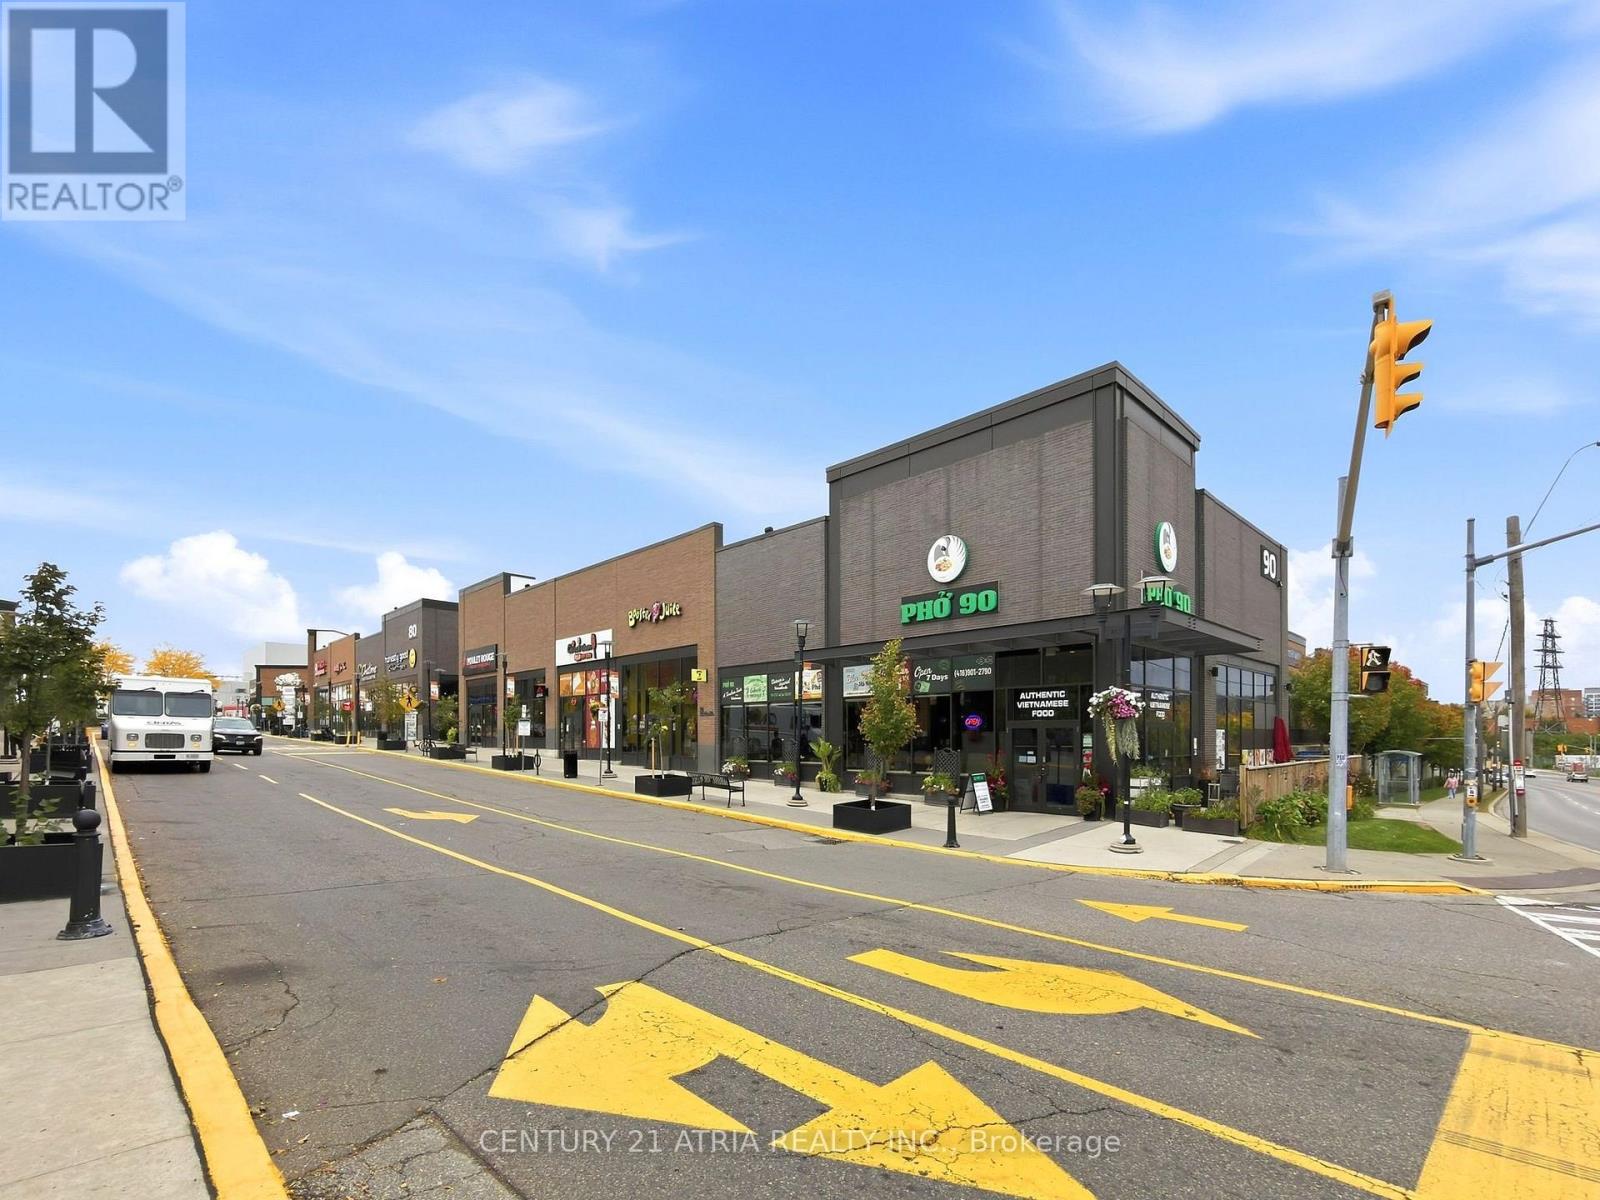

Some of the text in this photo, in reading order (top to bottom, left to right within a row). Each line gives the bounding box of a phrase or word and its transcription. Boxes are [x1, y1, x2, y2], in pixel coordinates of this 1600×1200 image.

[1263, 549, 1277, 579] 90
[959, 589, 998, 615] 90
[660, 602, 681, 620] Juice
[408, 624, 417, 639] 80
[914, 666, 932, 679] Open
[931, 674, 949, 682] Days
[1020, 690, 1066, 700] AUTHENTIC
[1016, 699, 1069, 709] VIETNAMESE
[1031, 709, 1055, 718] FOOD
